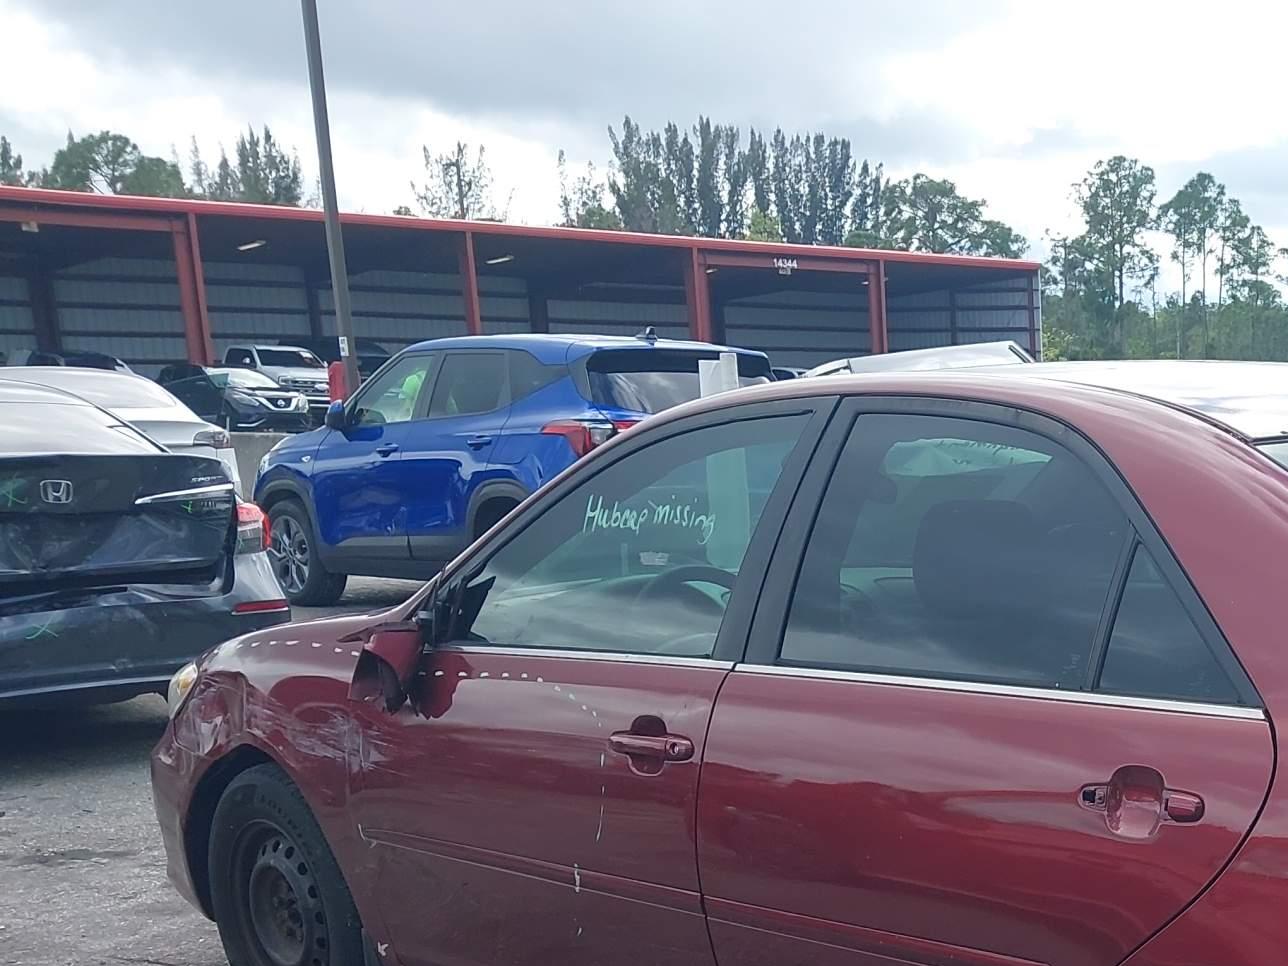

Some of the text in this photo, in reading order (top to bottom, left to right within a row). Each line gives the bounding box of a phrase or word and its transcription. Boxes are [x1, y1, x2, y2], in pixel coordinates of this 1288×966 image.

[773, 258, 798, 269] 14344
[583, 494, 716, 545] Hubcap missing
